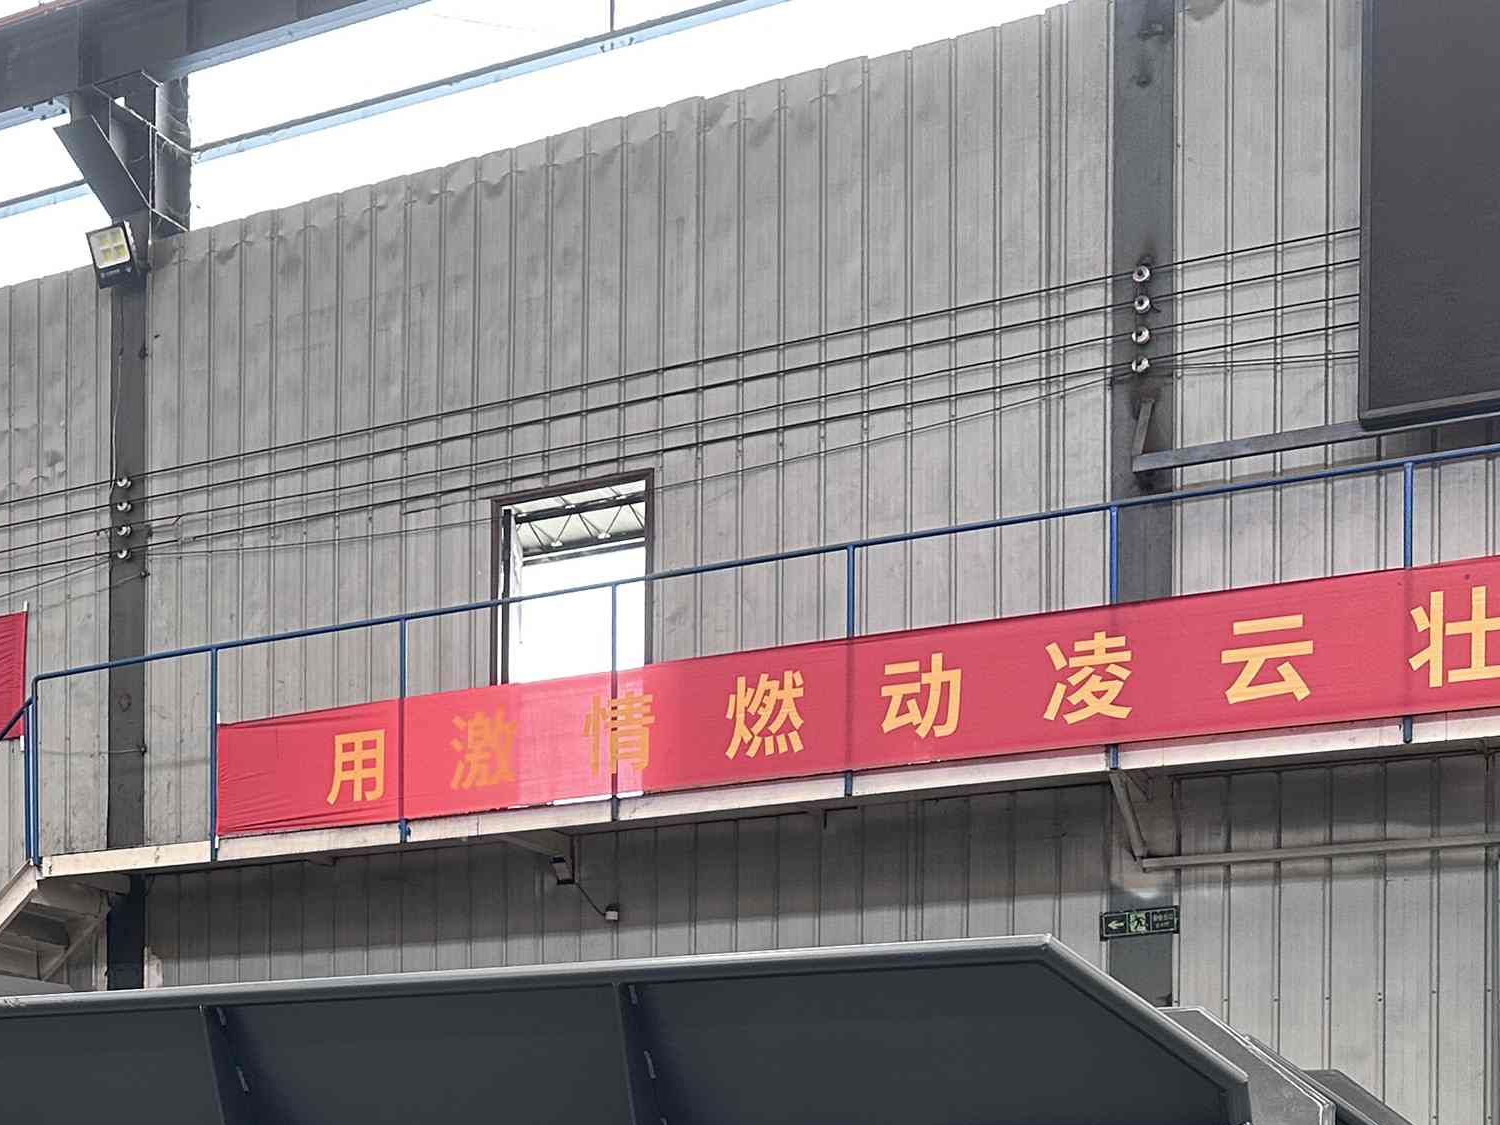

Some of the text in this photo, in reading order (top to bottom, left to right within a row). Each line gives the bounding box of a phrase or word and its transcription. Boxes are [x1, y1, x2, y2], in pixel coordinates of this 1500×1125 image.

[327, 586, 1500, 805] 用激情燃动凌云壮
